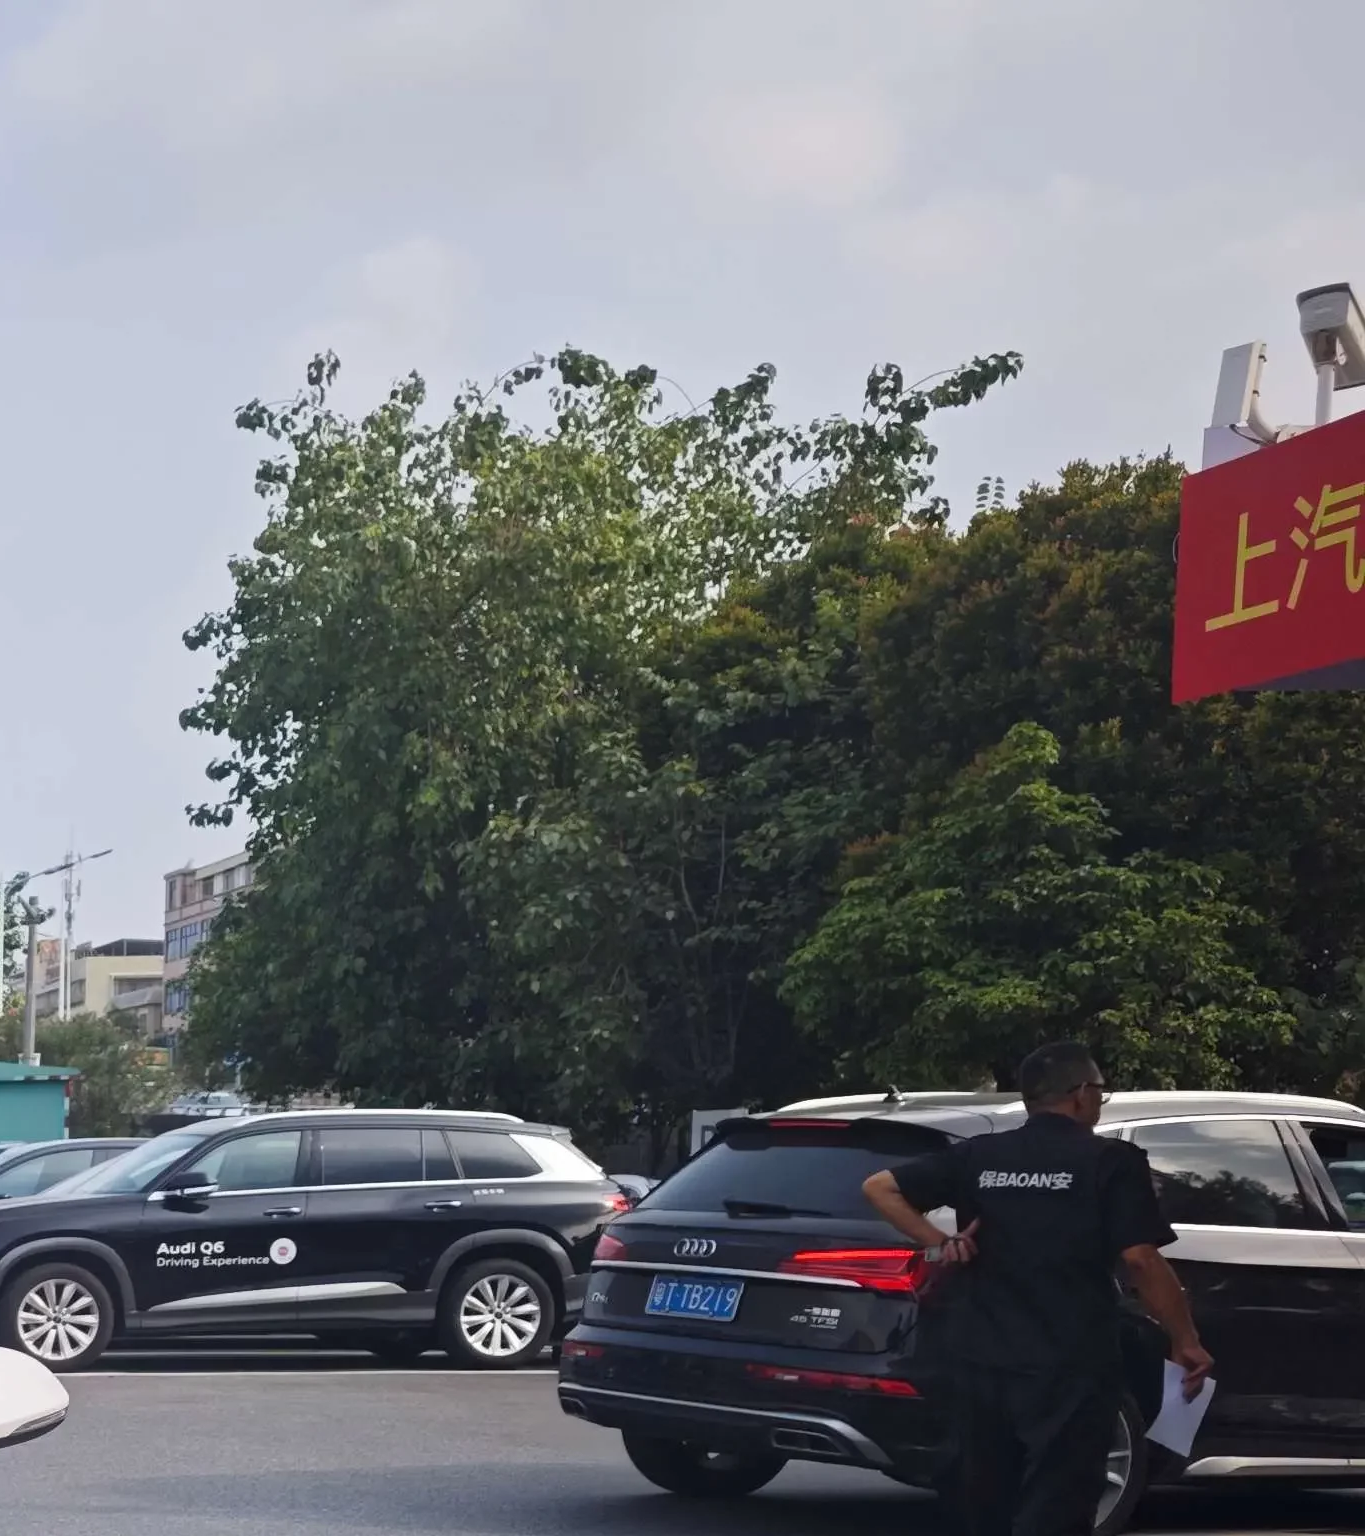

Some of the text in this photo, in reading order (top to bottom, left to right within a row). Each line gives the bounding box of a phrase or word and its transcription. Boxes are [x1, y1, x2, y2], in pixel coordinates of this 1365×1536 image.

[1205, 481, 1365, 632] 上汽
[979, 1170, 1073, 1190] 保BAOAN安
[156, 1241, 225, 1255] Audi Q6
[156, 1255, 269, 1268] Driving Experience
